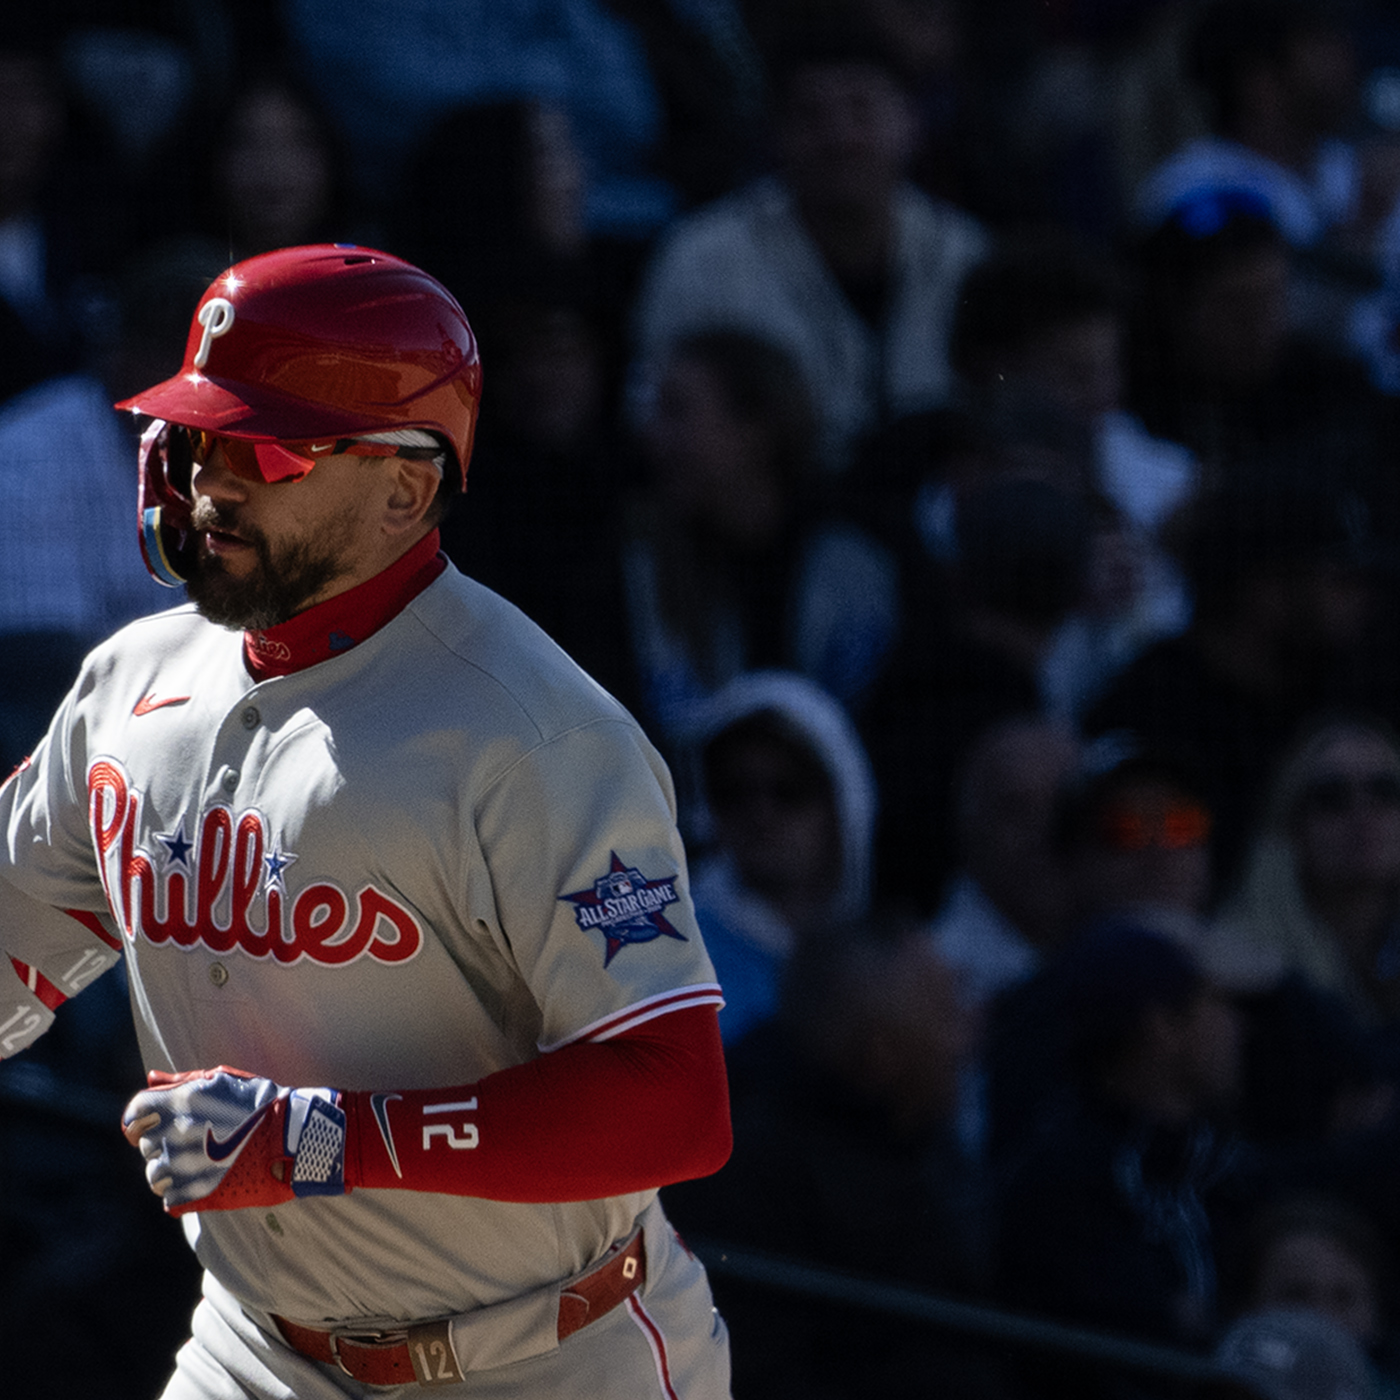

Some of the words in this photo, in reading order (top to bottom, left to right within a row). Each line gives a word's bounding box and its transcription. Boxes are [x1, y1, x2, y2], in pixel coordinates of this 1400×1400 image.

[198, 298, 235, 367] P
[88, 757, 424, 966] Phillies
[579, 905, 605, 927] ALL
[603, 896, 638, 918] STAR
[62, 948, 107, 990] 12
[422, 1096, 479, 1151] 12
[415, 1340, 454, 1382] 12
